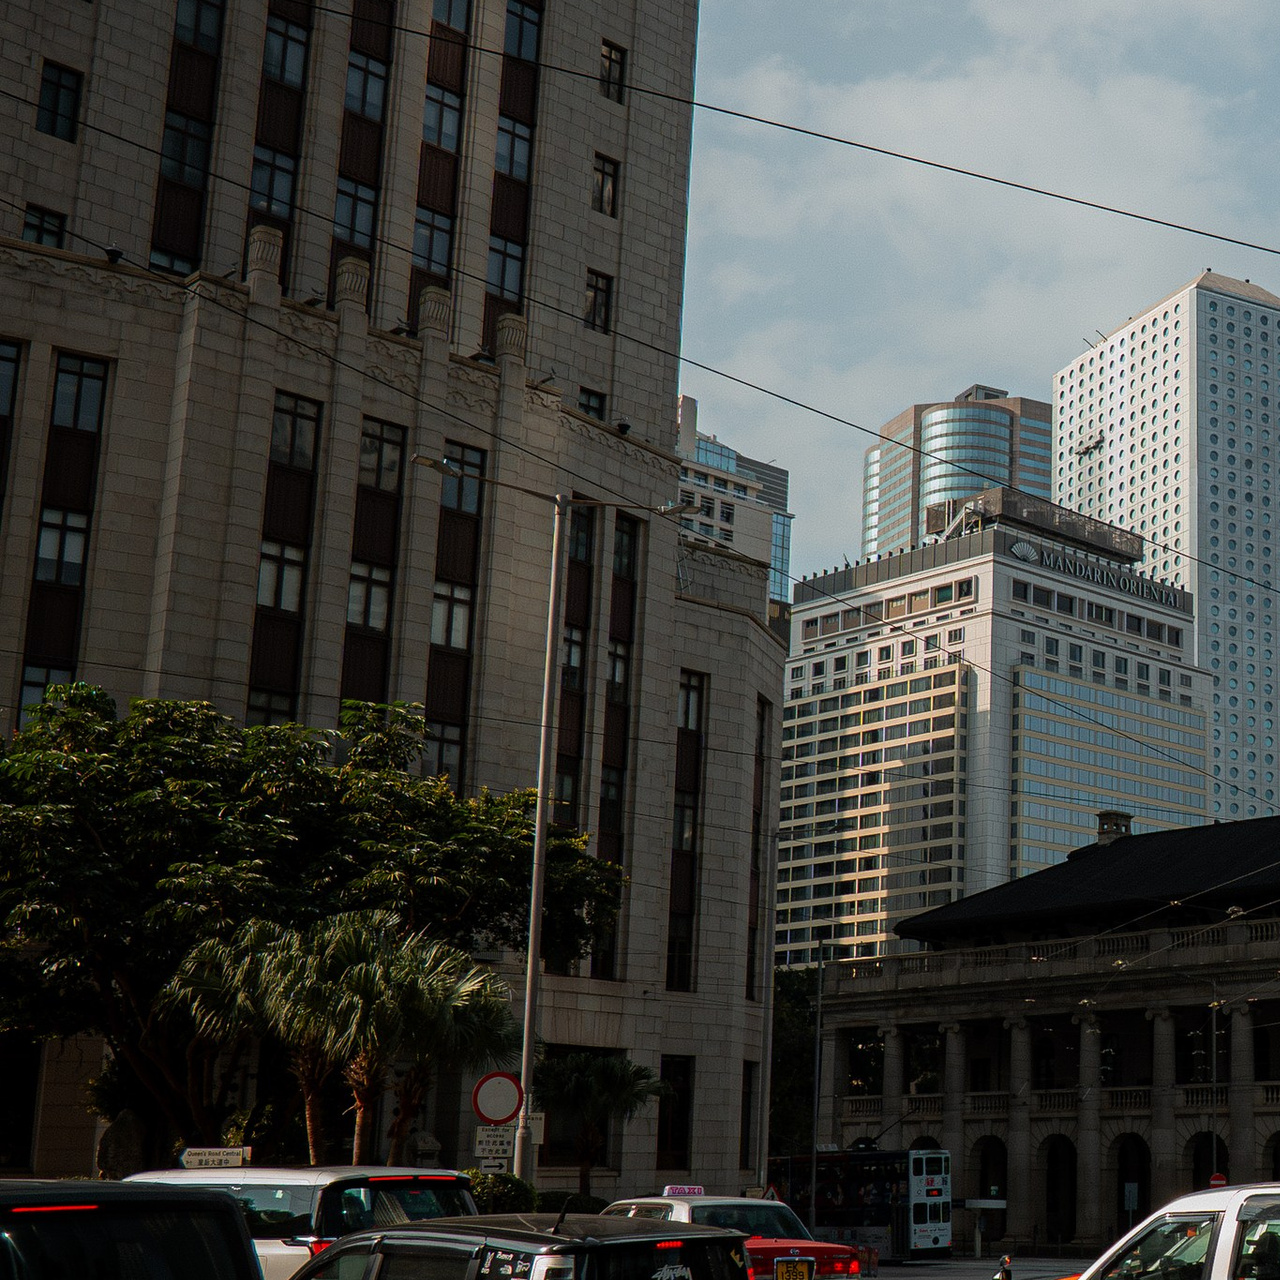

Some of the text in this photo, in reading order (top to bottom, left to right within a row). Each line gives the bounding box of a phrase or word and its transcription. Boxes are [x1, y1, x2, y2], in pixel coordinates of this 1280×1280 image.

[1041, 550, 1182, 608] MANDARIN ORIENTAL
[670, 1186, 702, 1195] TAXI
[786, 1262, 799, 1272] EK
[781, 1271, 805, 1280] 1399
